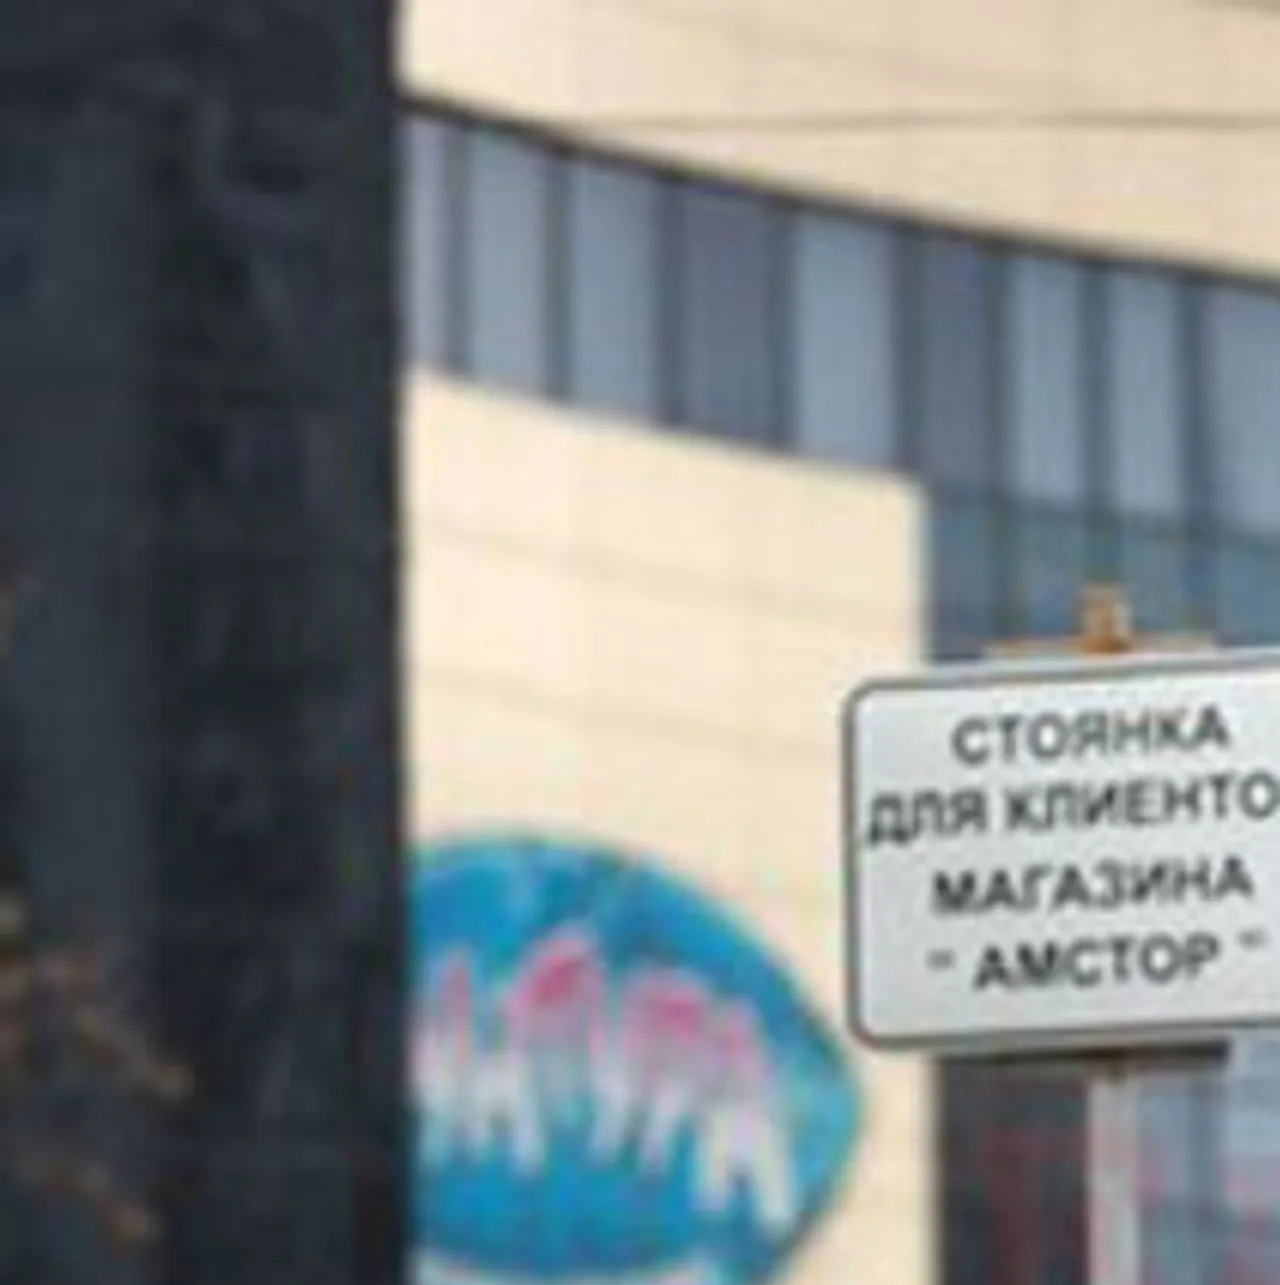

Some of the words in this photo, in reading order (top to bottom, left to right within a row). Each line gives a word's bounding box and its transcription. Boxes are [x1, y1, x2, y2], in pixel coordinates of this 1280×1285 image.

[950, 705, 1231, 767] СТОЯНКА
[866, 789, 988, 848] ДЛЯ
[930, 855, 1253, 917] МАГАЗИНА
